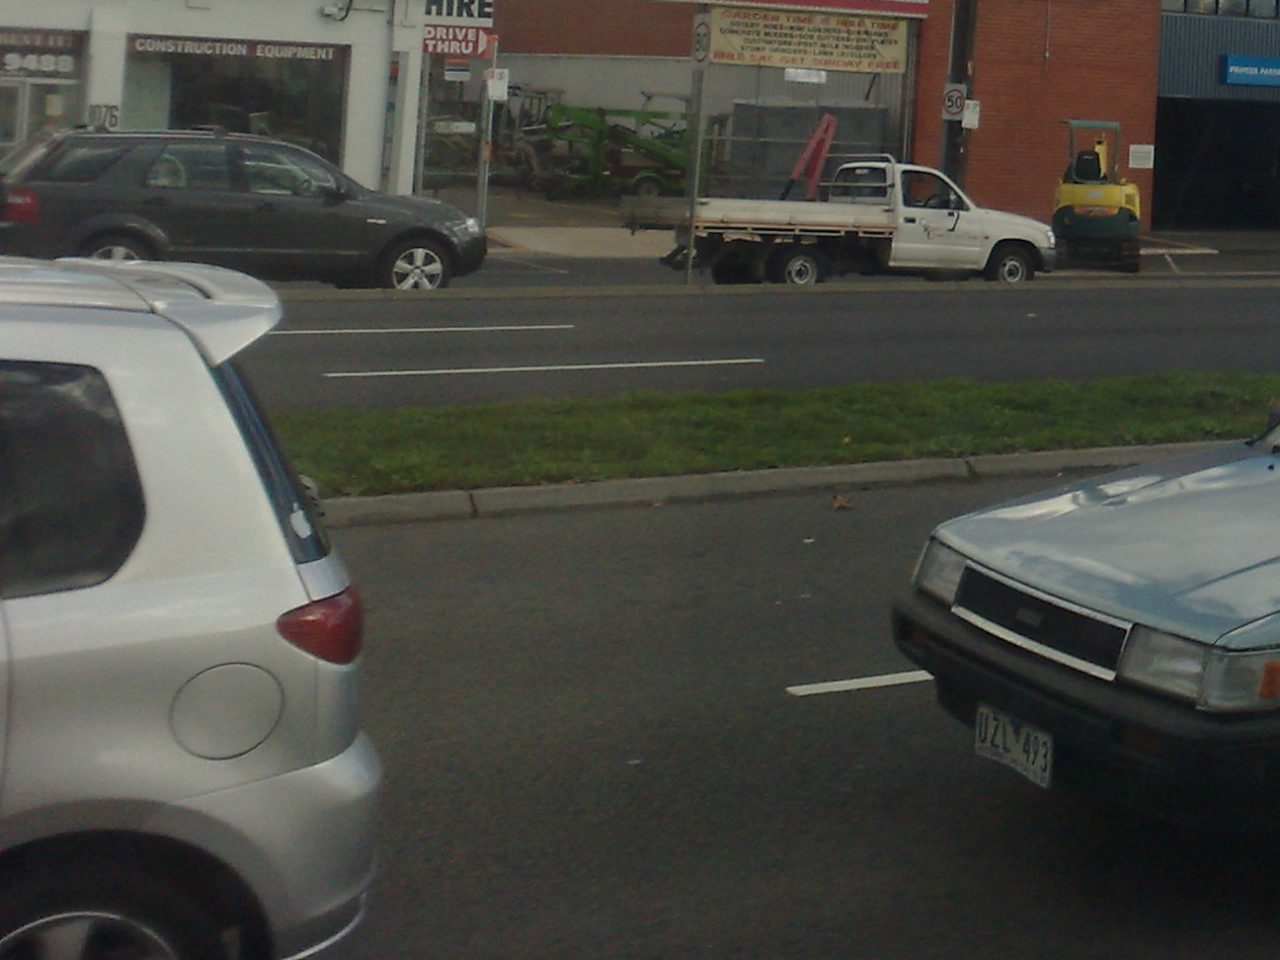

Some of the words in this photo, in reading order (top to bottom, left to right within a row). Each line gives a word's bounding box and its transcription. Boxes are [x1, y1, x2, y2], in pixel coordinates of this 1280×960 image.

[424, 27, 477, 41] DRIVE
[135, 38, 248, 56] CONSTRUCTION
[256, 44, 334, 60] EQUIPMENT
[425, 40, 474, 54] THRU
[947, 94, 963, 109] 50
